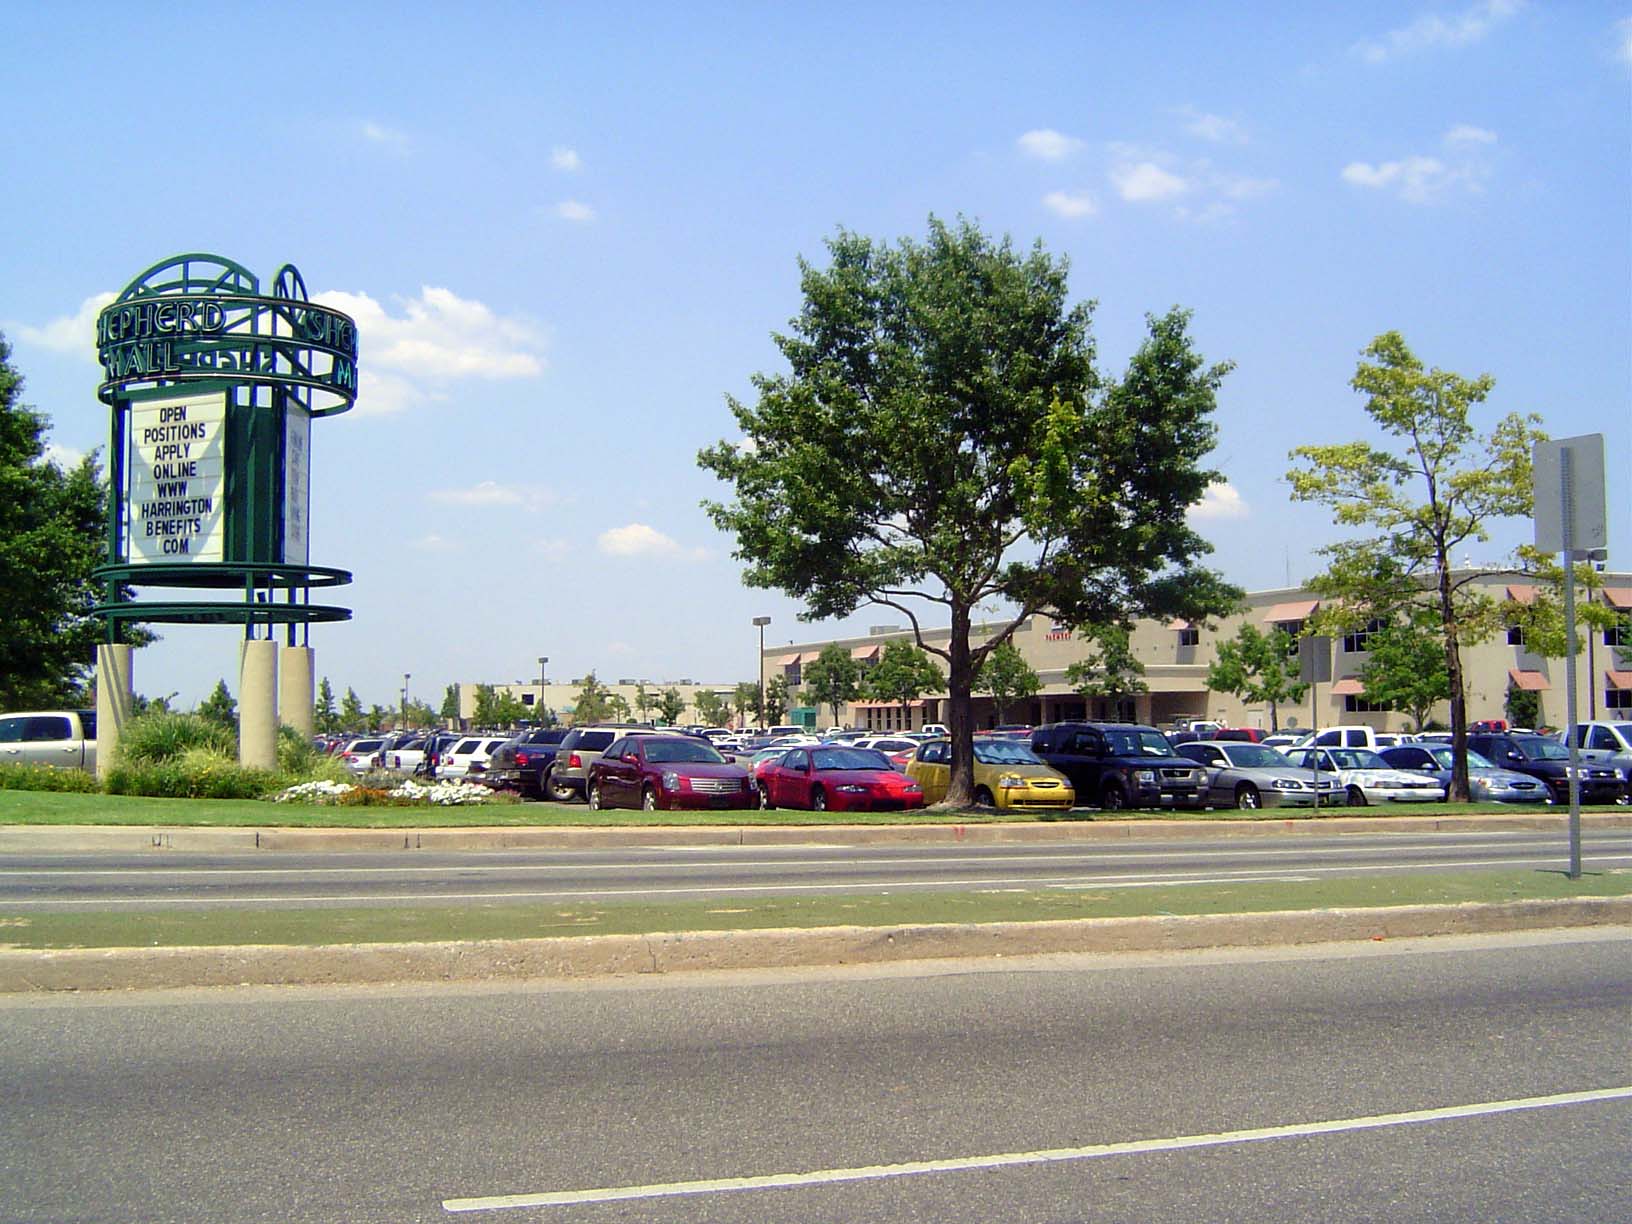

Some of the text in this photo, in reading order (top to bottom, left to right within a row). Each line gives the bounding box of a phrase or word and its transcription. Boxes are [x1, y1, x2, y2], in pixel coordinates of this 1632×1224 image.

[108, 341, 181, 378] MALL
[160, 406, 187, 423] OPEN
[144, 423, 206, 444] POSITIONS
[154, 443, 191, 461] APPLY
[153, 461, 197, 480] ONLINE
[157, 481, 188, 498] WWW
[141, 498, 212, 519] HARRINGTON
[146, 518, 201, 536] BENEFITS
[163, 538, 189, 554] COM
